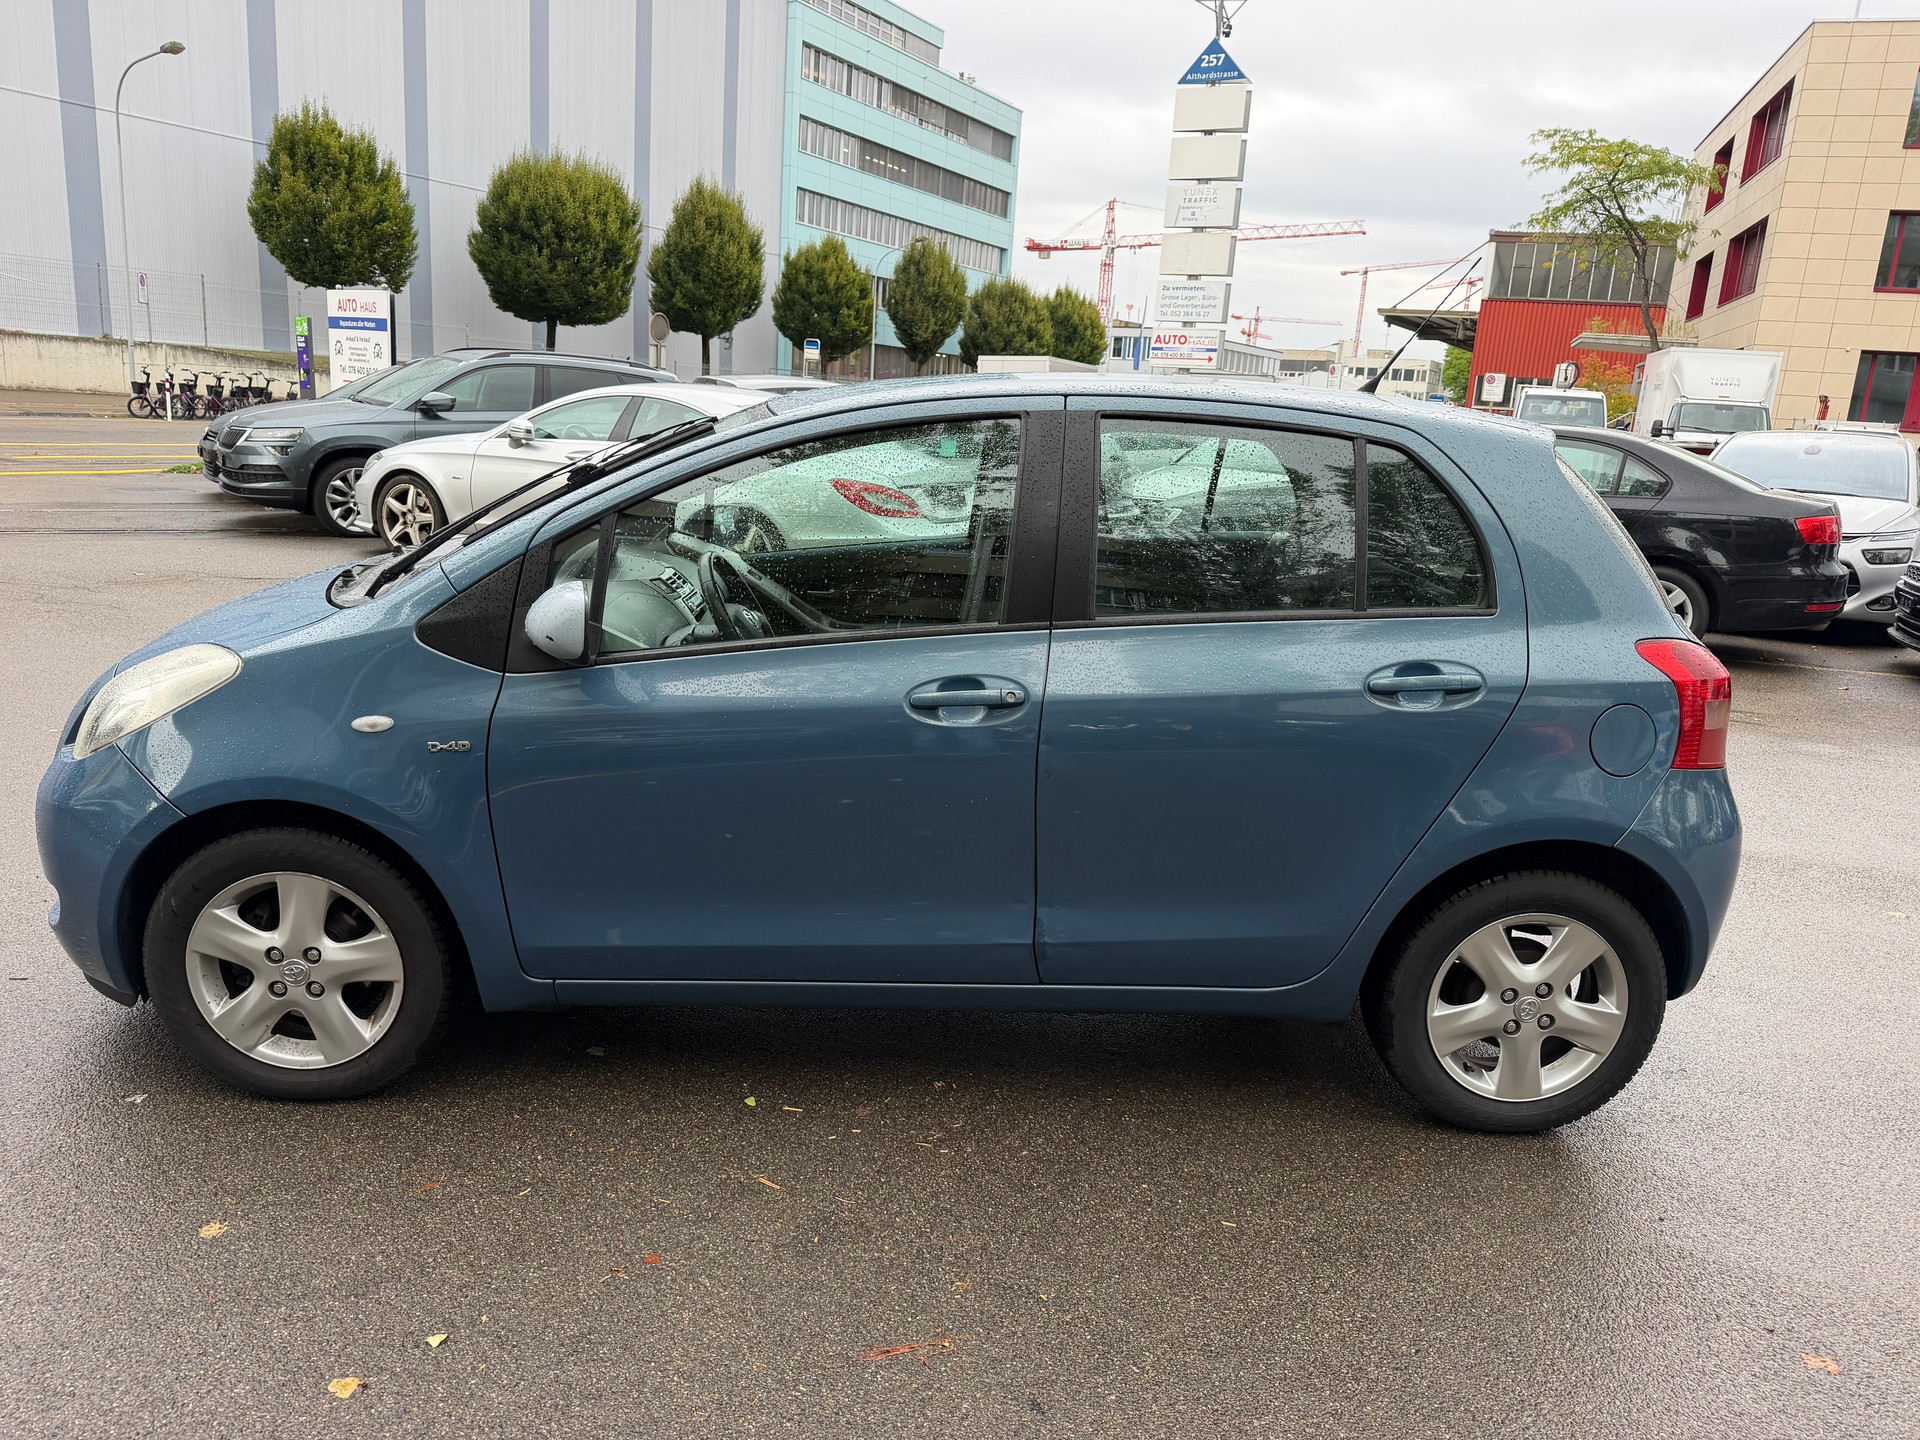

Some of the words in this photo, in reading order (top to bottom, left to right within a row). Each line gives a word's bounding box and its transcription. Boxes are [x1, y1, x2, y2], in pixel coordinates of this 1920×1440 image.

[1200, 53, 1225, 67] 257
[1186, 70, 1239, 80] Althardstrasse
[1183, 187, 1218, 196] YUNEX
[1183, 196, 1218, 204] TRAFFIC
[337, 298, 358, 312] AUTO
[360, 301, 377, 313] HAUS
[1153, 334, 1188, 345] AUTO
[427, 740, 470, 752] D-4D
